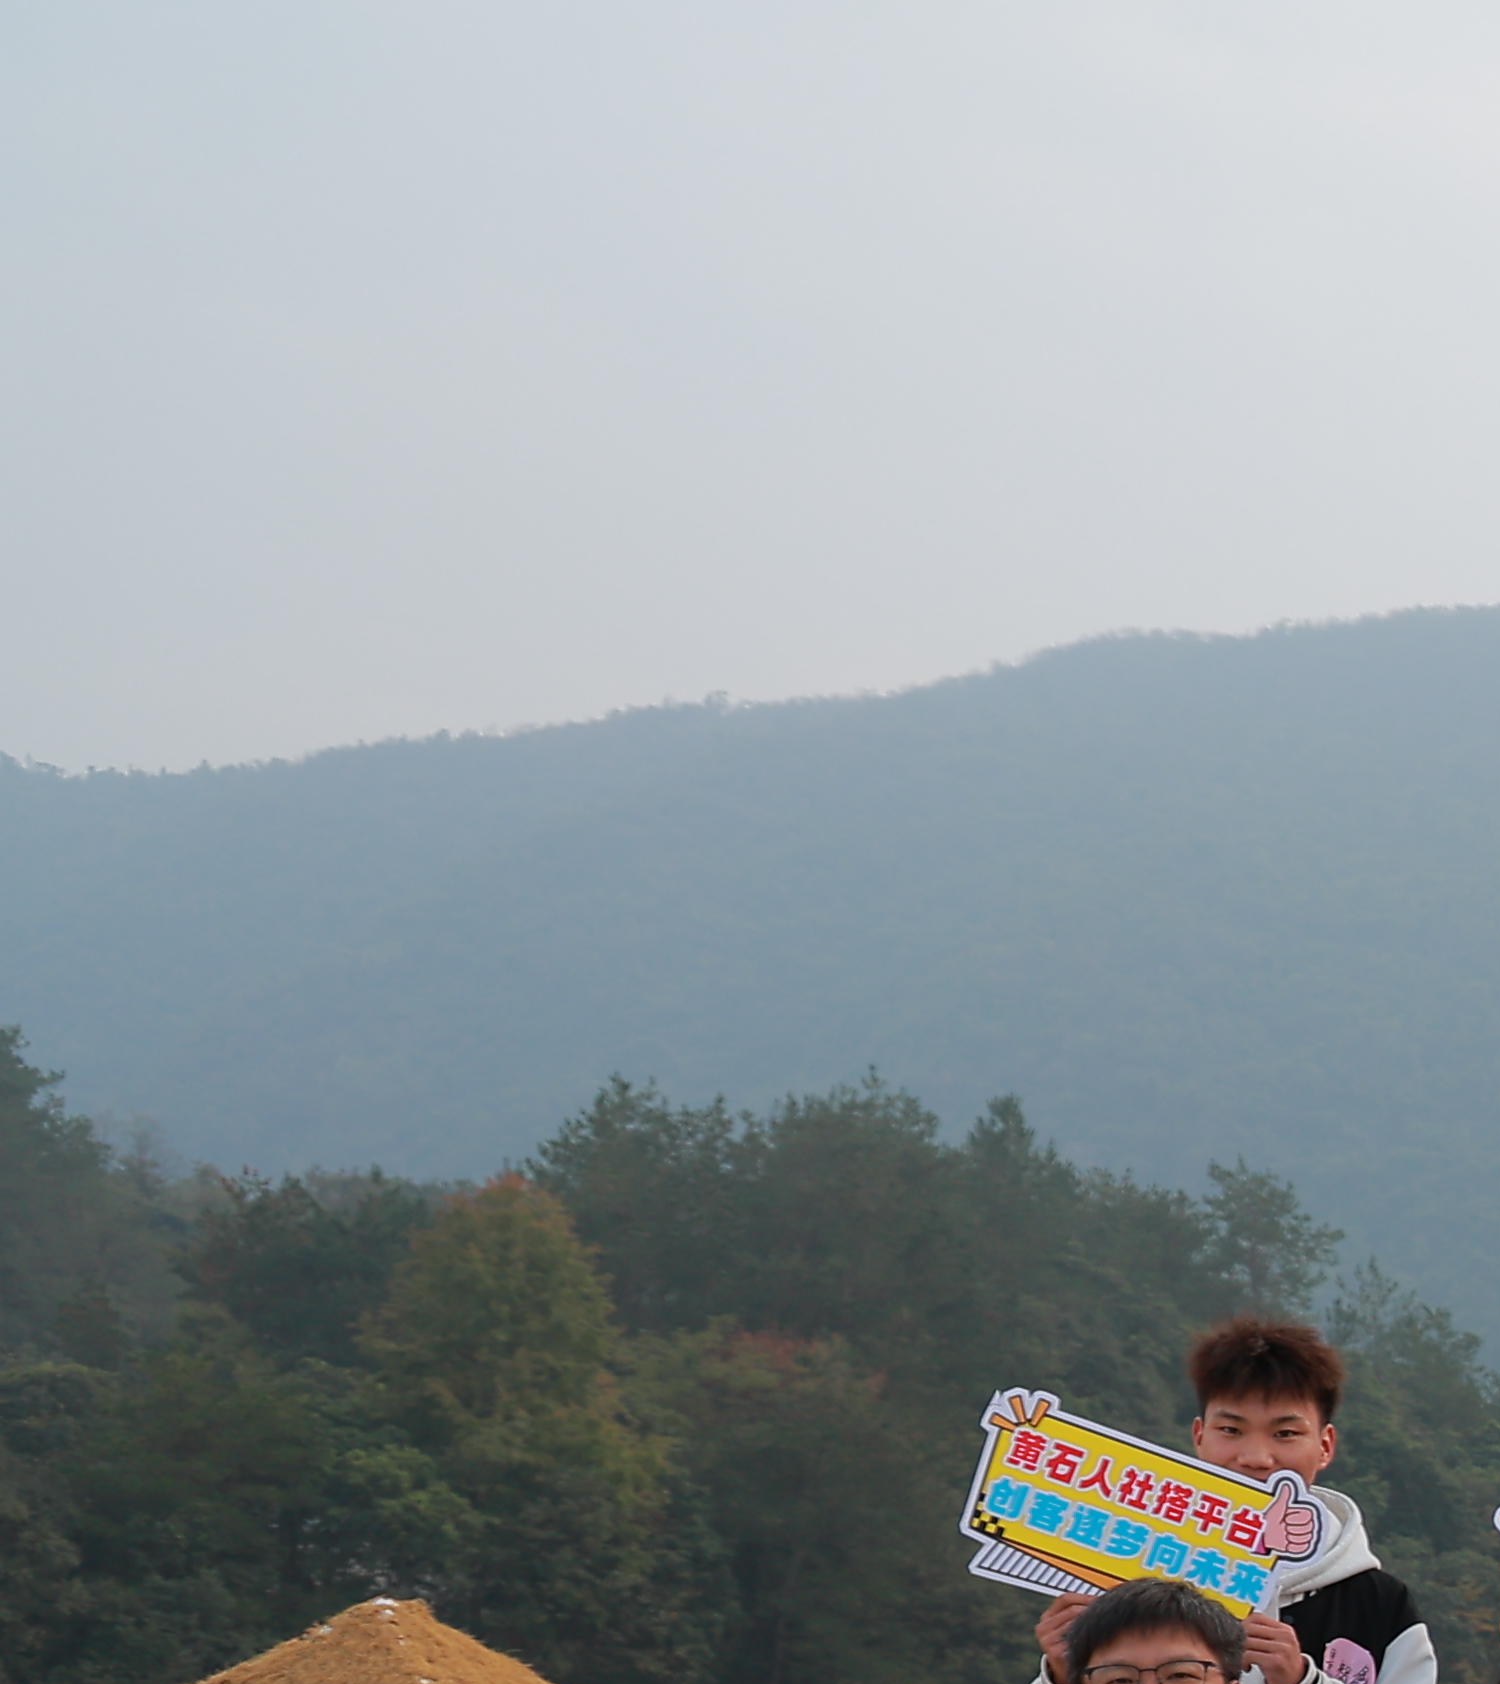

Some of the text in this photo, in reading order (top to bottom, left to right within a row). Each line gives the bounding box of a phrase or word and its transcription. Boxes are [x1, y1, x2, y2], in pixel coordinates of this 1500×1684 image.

[986, 1478, 1269, 1605] 创客逐梦向未来
[1007, 1428, 1264, 1549] 黄石人社搭平台
